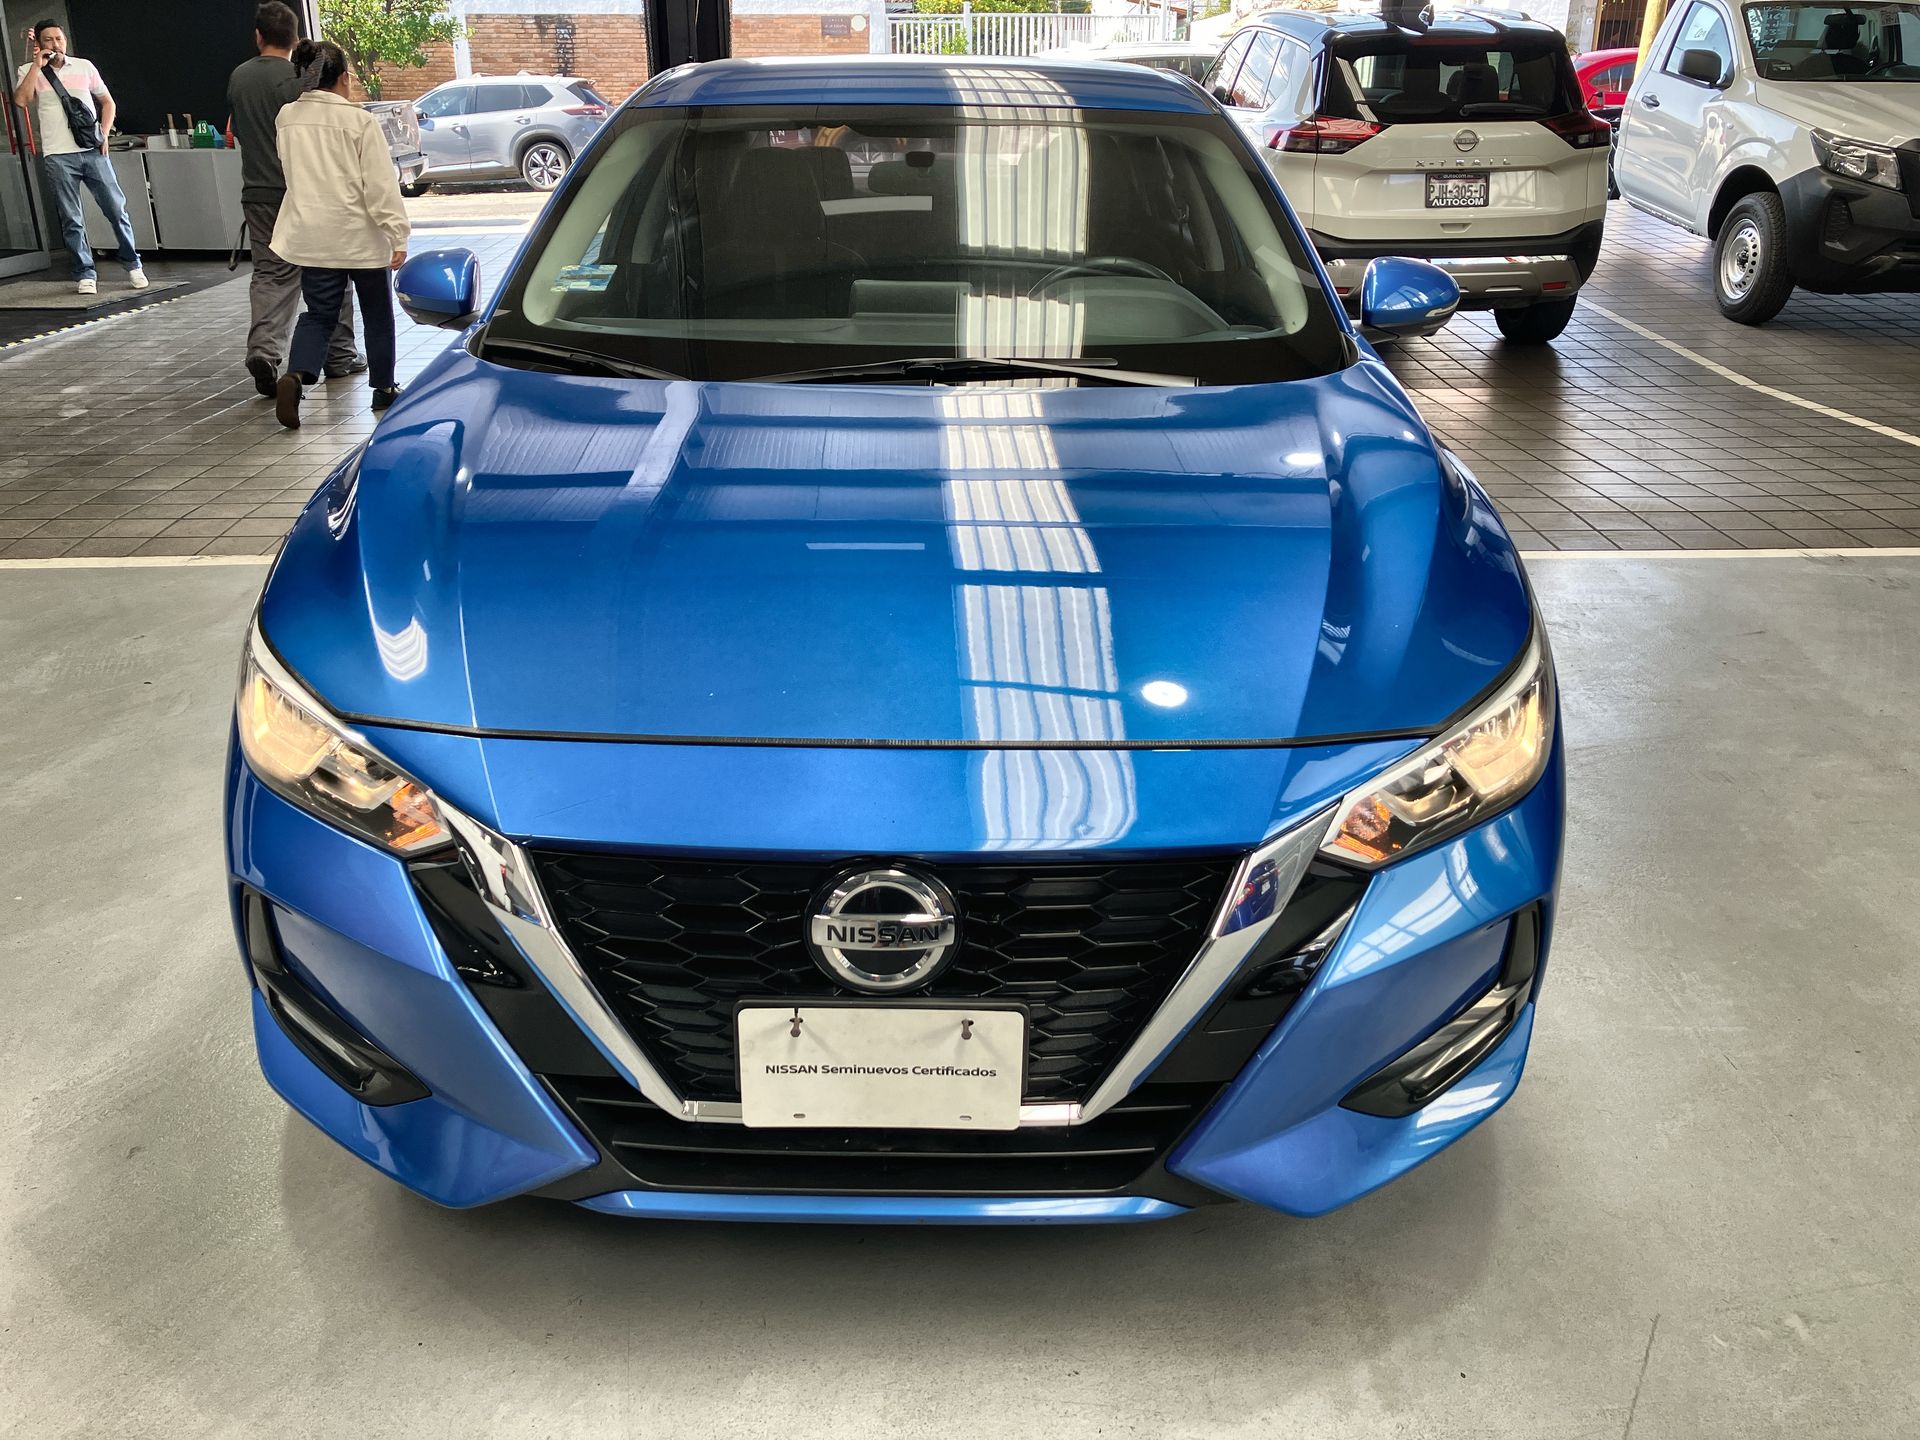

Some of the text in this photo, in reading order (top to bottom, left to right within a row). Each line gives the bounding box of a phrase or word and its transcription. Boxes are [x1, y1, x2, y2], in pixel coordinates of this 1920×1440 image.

[198, 122, 206, 133] 13
[1416, 158, 1510, 167] X-TRAIL
[1428, 184, 1486, 199] PJH-305-D
[1432, 197, 1484, 206] AUTOCOM
[826, 924, 940, 944] NISSAN
[765, 1064, 997, 1077] NISSAN Seminuevos Certificados
